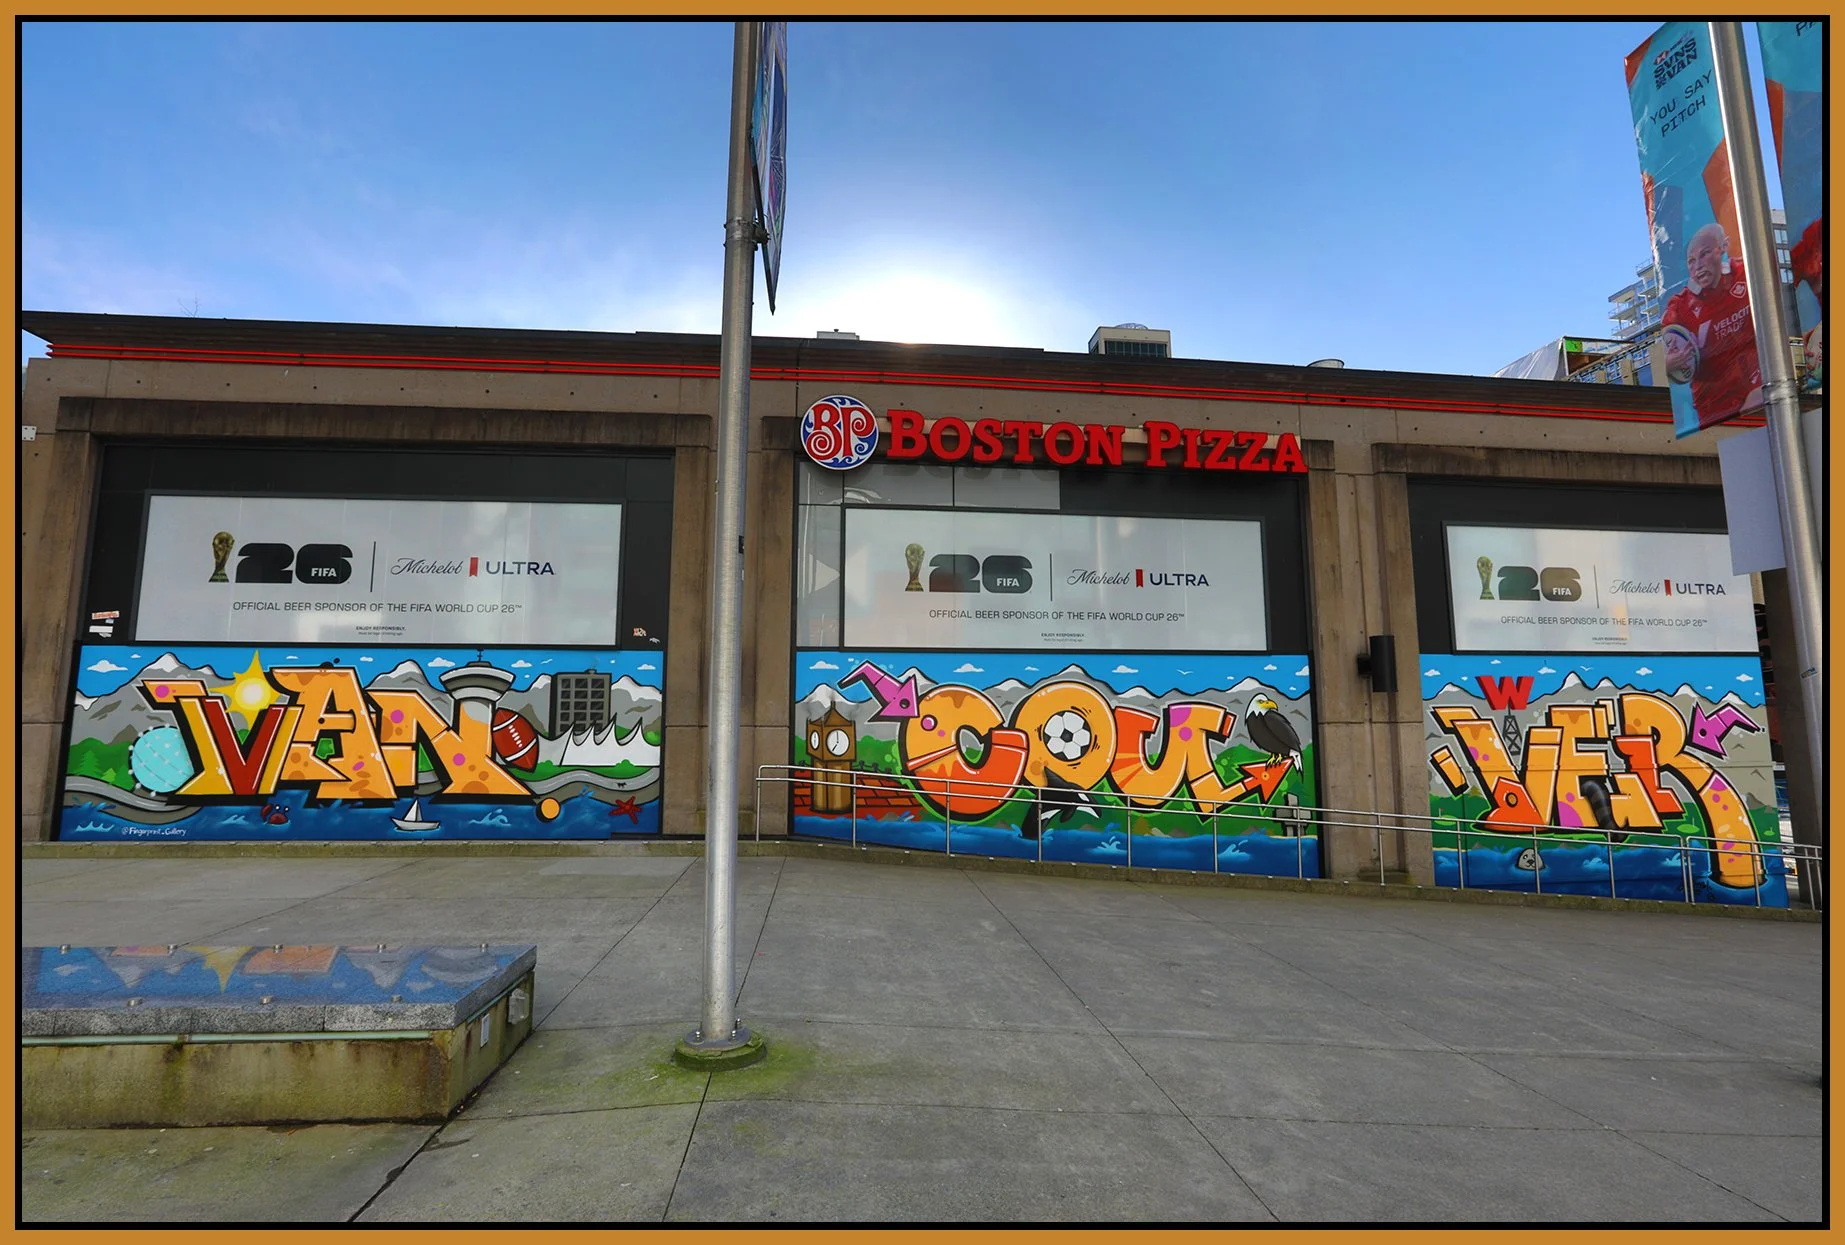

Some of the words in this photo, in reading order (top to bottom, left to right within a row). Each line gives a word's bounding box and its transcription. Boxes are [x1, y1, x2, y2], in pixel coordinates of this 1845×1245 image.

[1665, 48, 1697, 79] VAN
[1650, 98, 1676, 125] YOU
[1684, 69, 1712, 99] SAY
[1661, 94, 1706, 138] PITCH
[1713, 305, 1750, 331] VELOCIT
[805, 402, 875, 461] BP
[235, 543, 353, 584] 26
[311, 567, 337, 577] FIFA
[390, 557, 464, 576] Michelob
[486, 561, 555, 576] ULTRA
[929, 554, 1033, 593] 26
[996, 578, 1020, 587] FIFA
[1067, 568, 1131, 586] Michelob
[1150, 573, 1209, 587] ULTRA
[1497, 566, 1582, 601] 26
[1609, 579, 1661, 594] Michelob
[1676, 583, 1726, 595] ULTRA
[1552, 587, 1572, 596] FIFA
[233, 602, 280, 611] OFFICIAL
[284, 602, 311, 611] BEER
[315, 602, 366, 612] SPONSOR
[369, 603, 383, 612] OF
[388, 603, 407, 613] THE
[410, 603, 432, 613] FIFA
[435, 604, 473, 613] WORLD
[477, 604, 498, 613] CUP
[929, 610, 972, 619] OFFICIAL
[975, 610, 1000, 619] BEER
[1002, 611, 1049, 620] SPONSOR
[1052, 611, 1064, 620] OF
[1067, 611, 1085, 620] THE
[1087, 612, 1106, 620] FIFA
[1109, 612, 1143, 621] WORLD
[1146, 613, 1165, 621] CUP
[1501, 616, 1536, 624] OFFICIAL
[1538, 617, 1558, 625] BEER
[1560, 617, 1597, 625] SPONSOR
[1599, 618, 1610, 626] OF
[1612, 618, 1626, 626] THE
[1628, 618, 1645, 626] FIFA
[1646, 618, 1674, 627] WORLD
[1675, 619, 1691, 627] CUP
[1476, 675, 1534, 711] W
